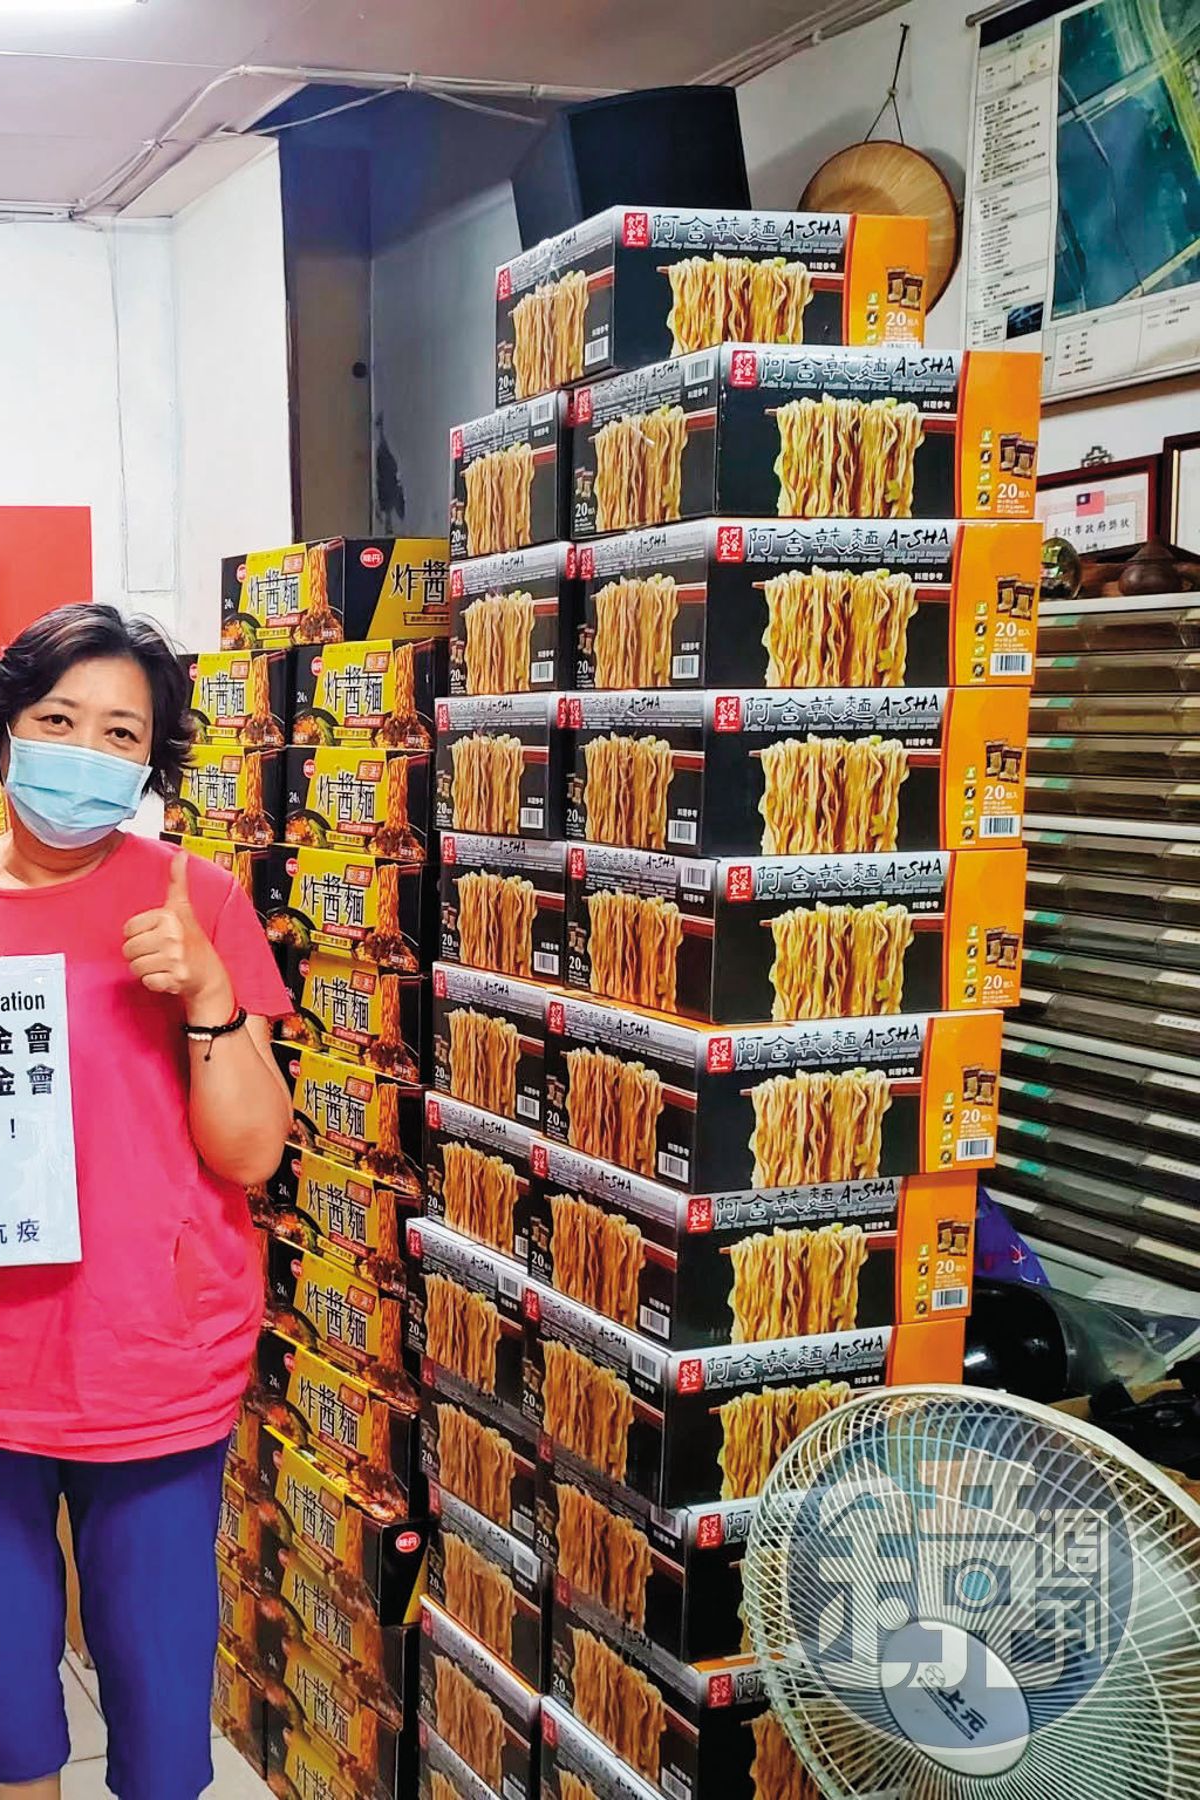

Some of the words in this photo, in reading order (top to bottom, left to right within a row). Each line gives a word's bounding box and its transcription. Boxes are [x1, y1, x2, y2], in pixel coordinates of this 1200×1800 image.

[782, 219, 842, 238] A-SHA
[894, 355, 955, 379] A-SHA
[885, 526, 950, 549] A-SHA
[323, 667, 382, 716] 炸醬麵
[878, 694, 940, 715] A-SHA
[317, 770, 376, 822] 炸醬麵
[884, 857, 943, 883] A-SHA
[300, 873, 365, 926] 炸醬麵
[312, 977, 370, 1032] 炸醬麵
[864, 1023, 921, 1047] A-SHA
[304, 1081, 365, 1138] 炸醬麵
[839, 1179, 896, 1203] A-SHA
[306, 1178, 366, 1244] 炸醬麵
[304, 1280, 367, 1351] 炸醬麵
[829, 1333, 884, 1362] A-SHA
[298, 1375, 358, 1451] 炸醬麵
